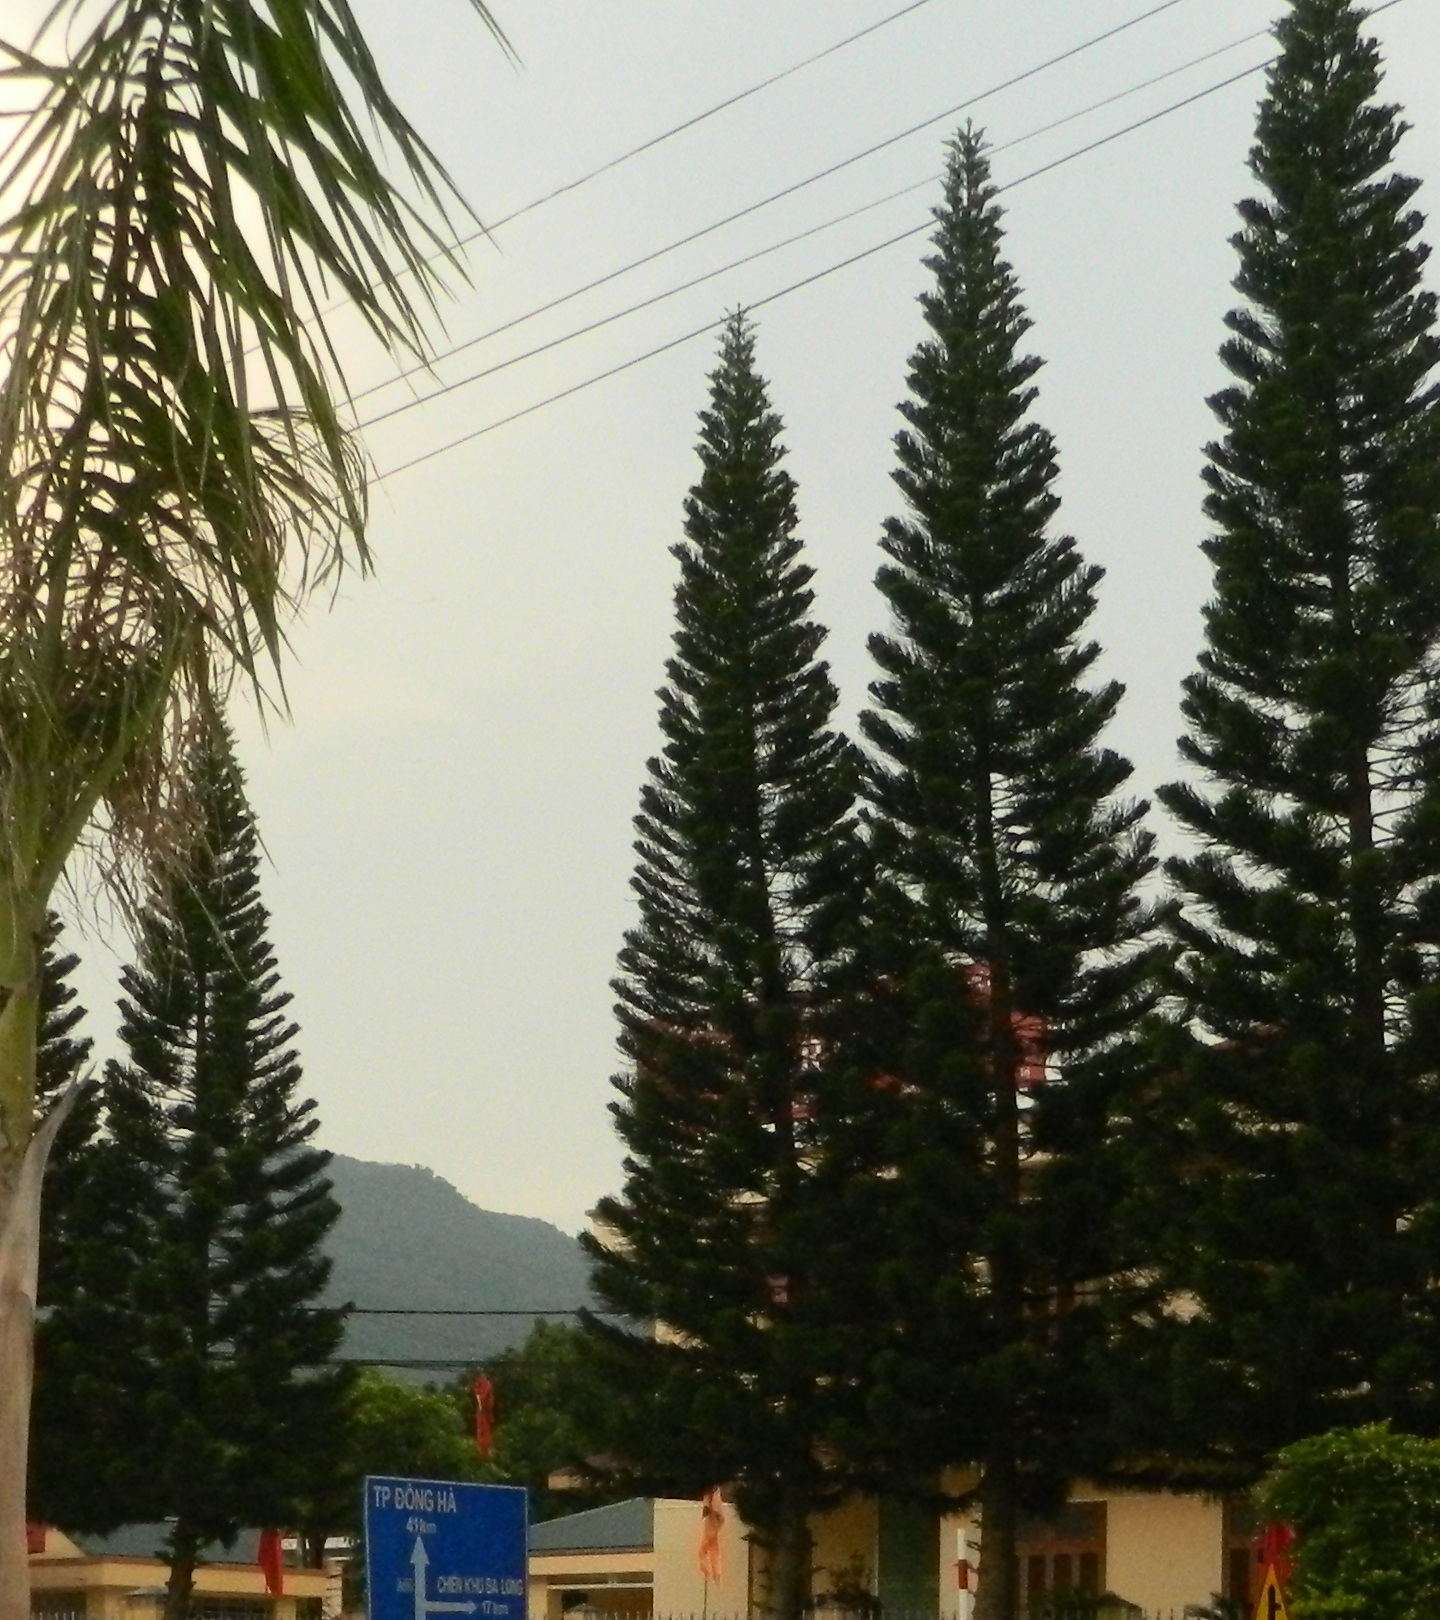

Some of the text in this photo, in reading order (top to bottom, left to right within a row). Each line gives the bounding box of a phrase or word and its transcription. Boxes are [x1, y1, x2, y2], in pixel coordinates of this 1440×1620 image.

[373, 1483, 457, 1513] TP ĐÔNG HÀ
